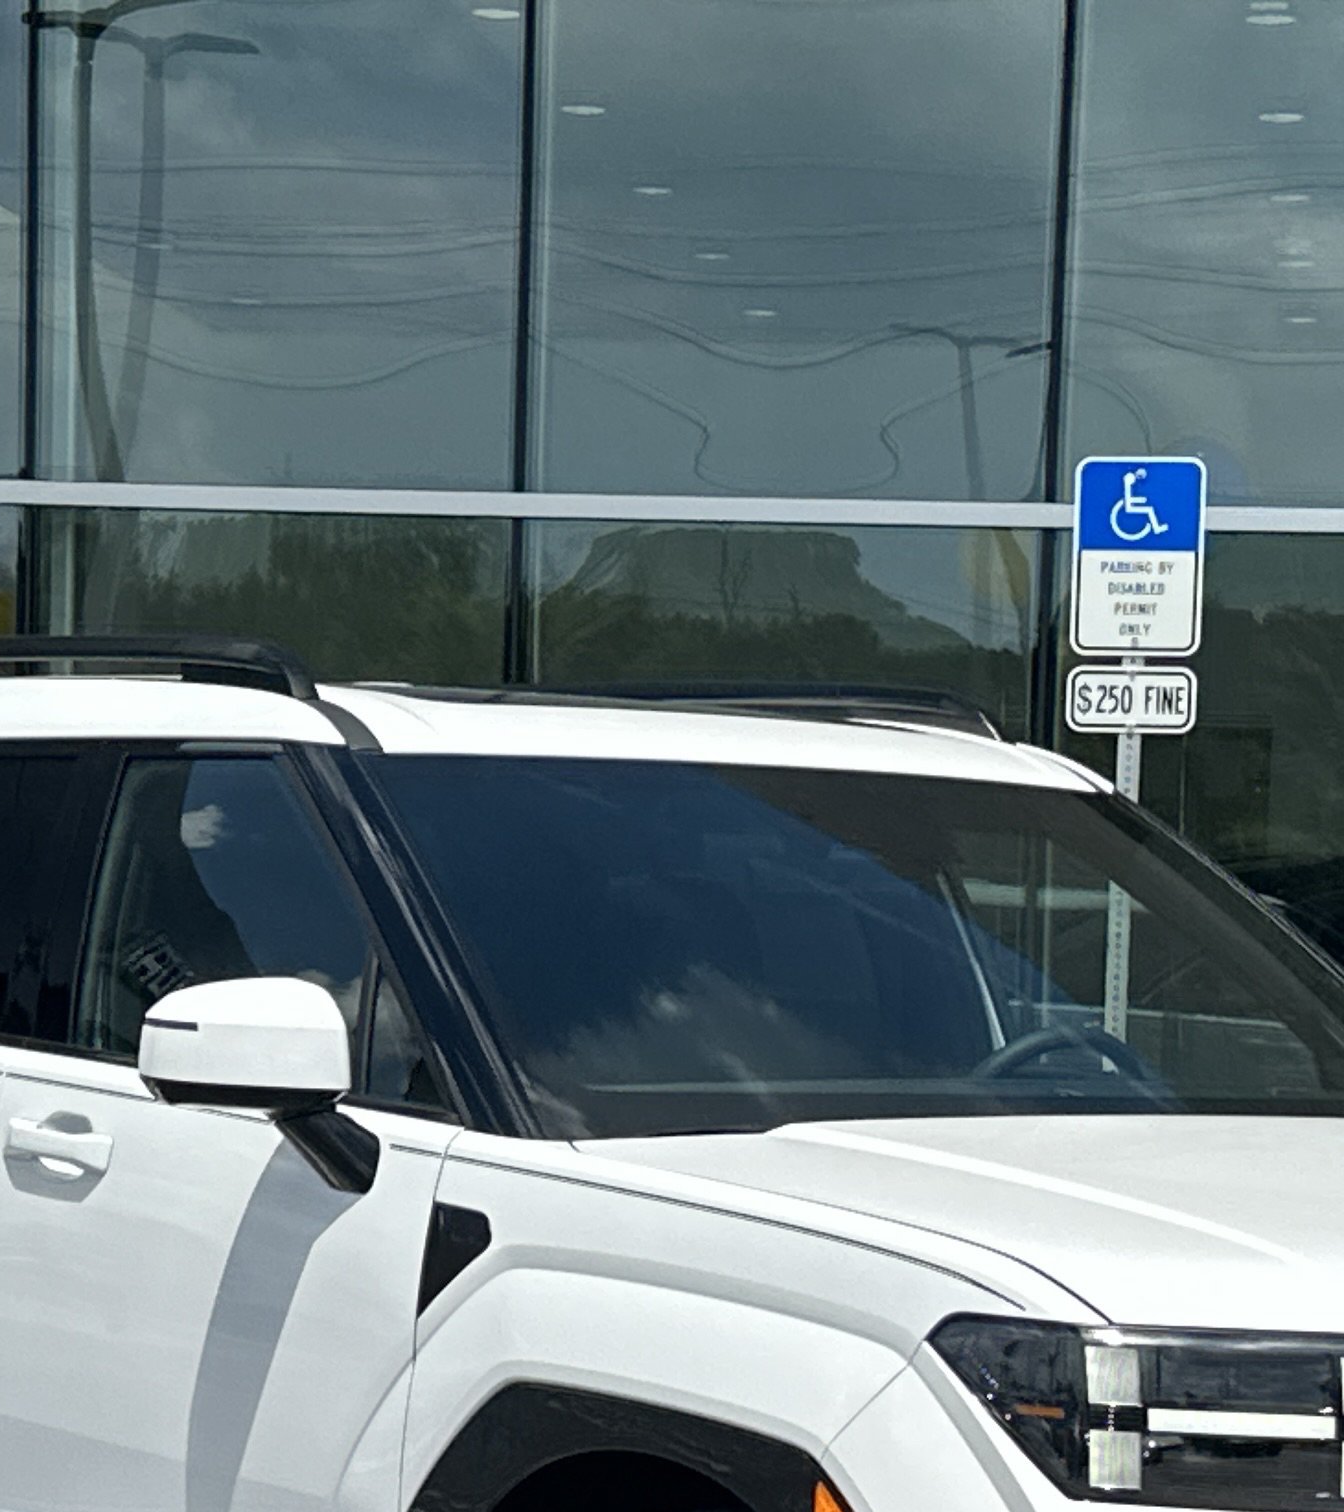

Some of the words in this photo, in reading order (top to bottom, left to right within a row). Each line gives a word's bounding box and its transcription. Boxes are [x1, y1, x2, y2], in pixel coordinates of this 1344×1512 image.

[1158, 561, 1175, 576] BY
[1107, 581, 1165, 596] DISABLED
[1076, 681, 1133, 717] $250
[1144, 685, 1186, 716] FINE
